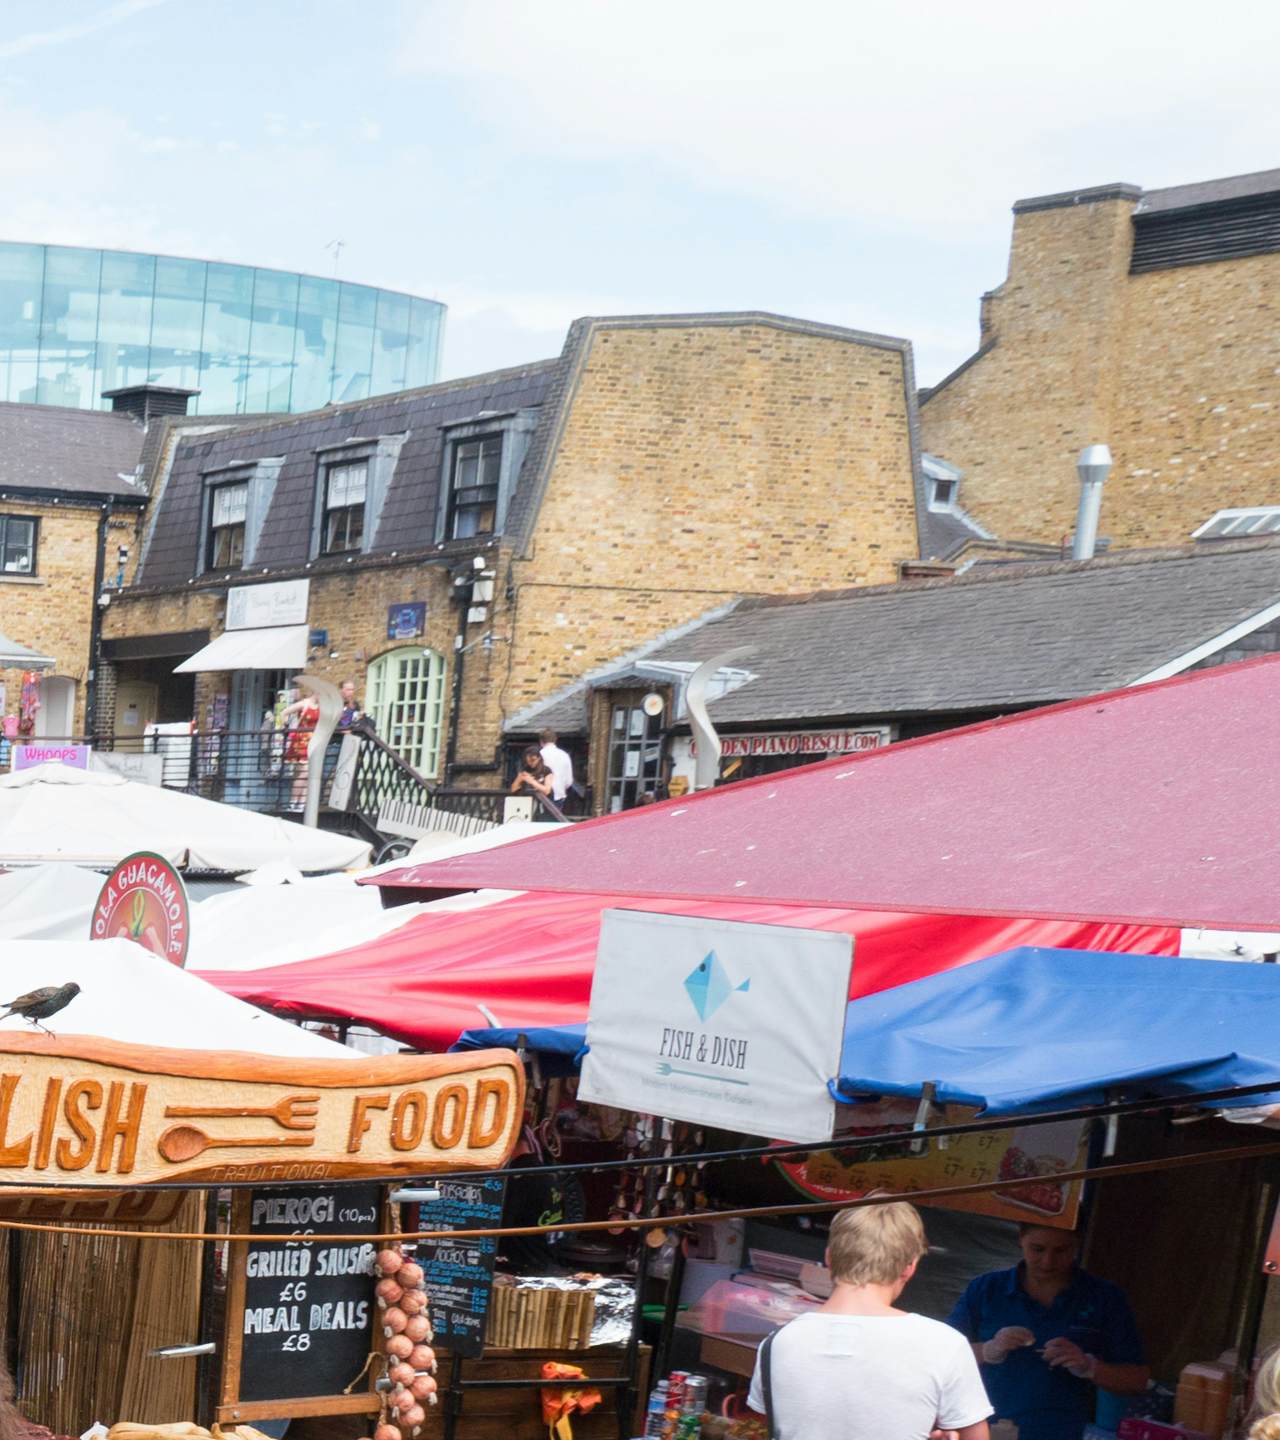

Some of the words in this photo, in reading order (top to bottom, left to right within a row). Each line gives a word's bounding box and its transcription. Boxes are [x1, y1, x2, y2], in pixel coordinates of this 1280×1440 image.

[25, 749, 77, 760] WHOOPS
[690, 737, 749, 755] CDEN
[754, 735, 799, 752] PIANO
[118, 862, 183, 955] GUACAMOLE
[659, 1028, 695, 1057] FISH
[696, 1035, 708, 1062] &
[711, 1036, 748, 1069] DISH
[348, 1078, 507, 1153] FOOD
[211, 1163, 334, 1180] TRADITIONAL
[246, 1249, 311, 1278] GRILLED
[279, 1282, 307, 1302] £6
[244, 1306, 301, 1334] MEAL
[309, 1301, 369, 1331] DEALS
[281, 1333, 311, 1351] £8
